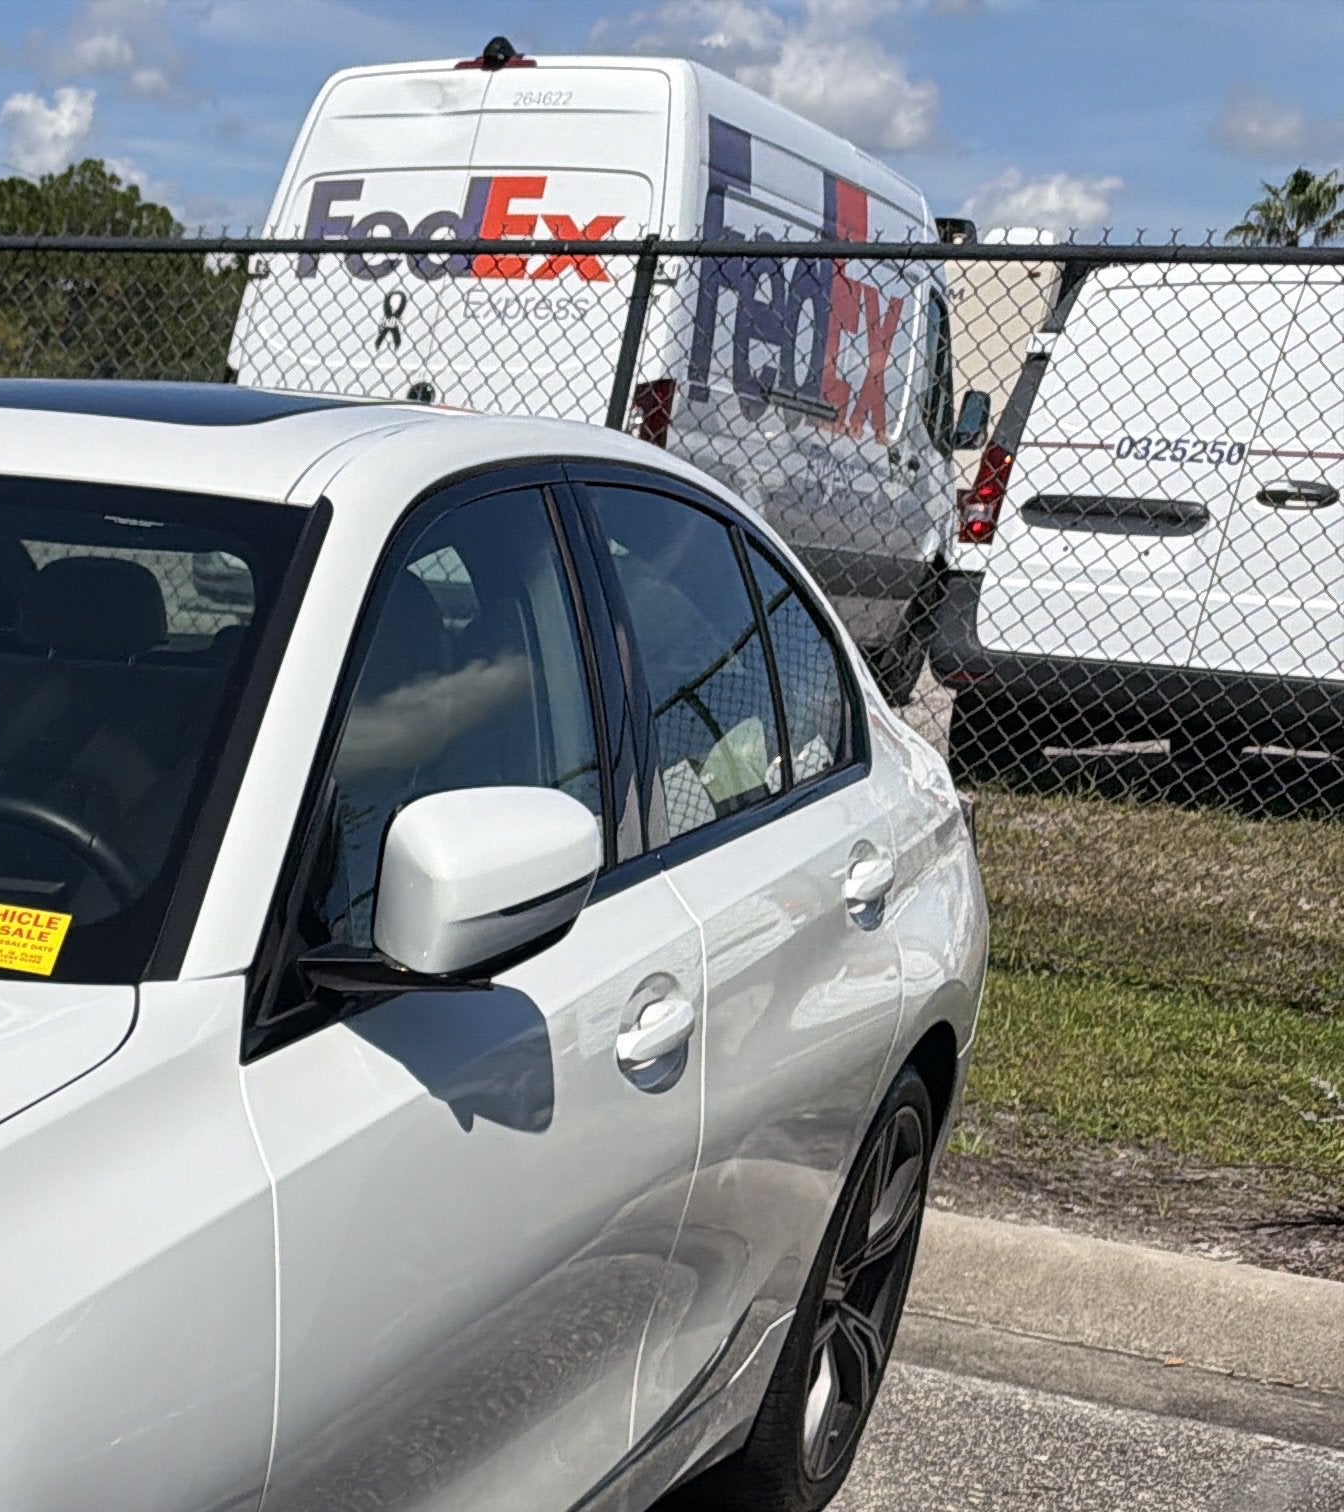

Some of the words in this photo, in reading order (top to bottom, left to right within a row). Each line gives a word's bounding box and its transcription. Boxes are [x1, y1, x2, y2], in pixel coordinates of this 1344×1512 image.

[296, 176, 625, 283] FedEx
[687, 113, 904, 444] FedEx
[464, 287, 589, 325] Express
[1115, 436, 1246, 466] 0325250
[30, 944, 53, 952] DATE
